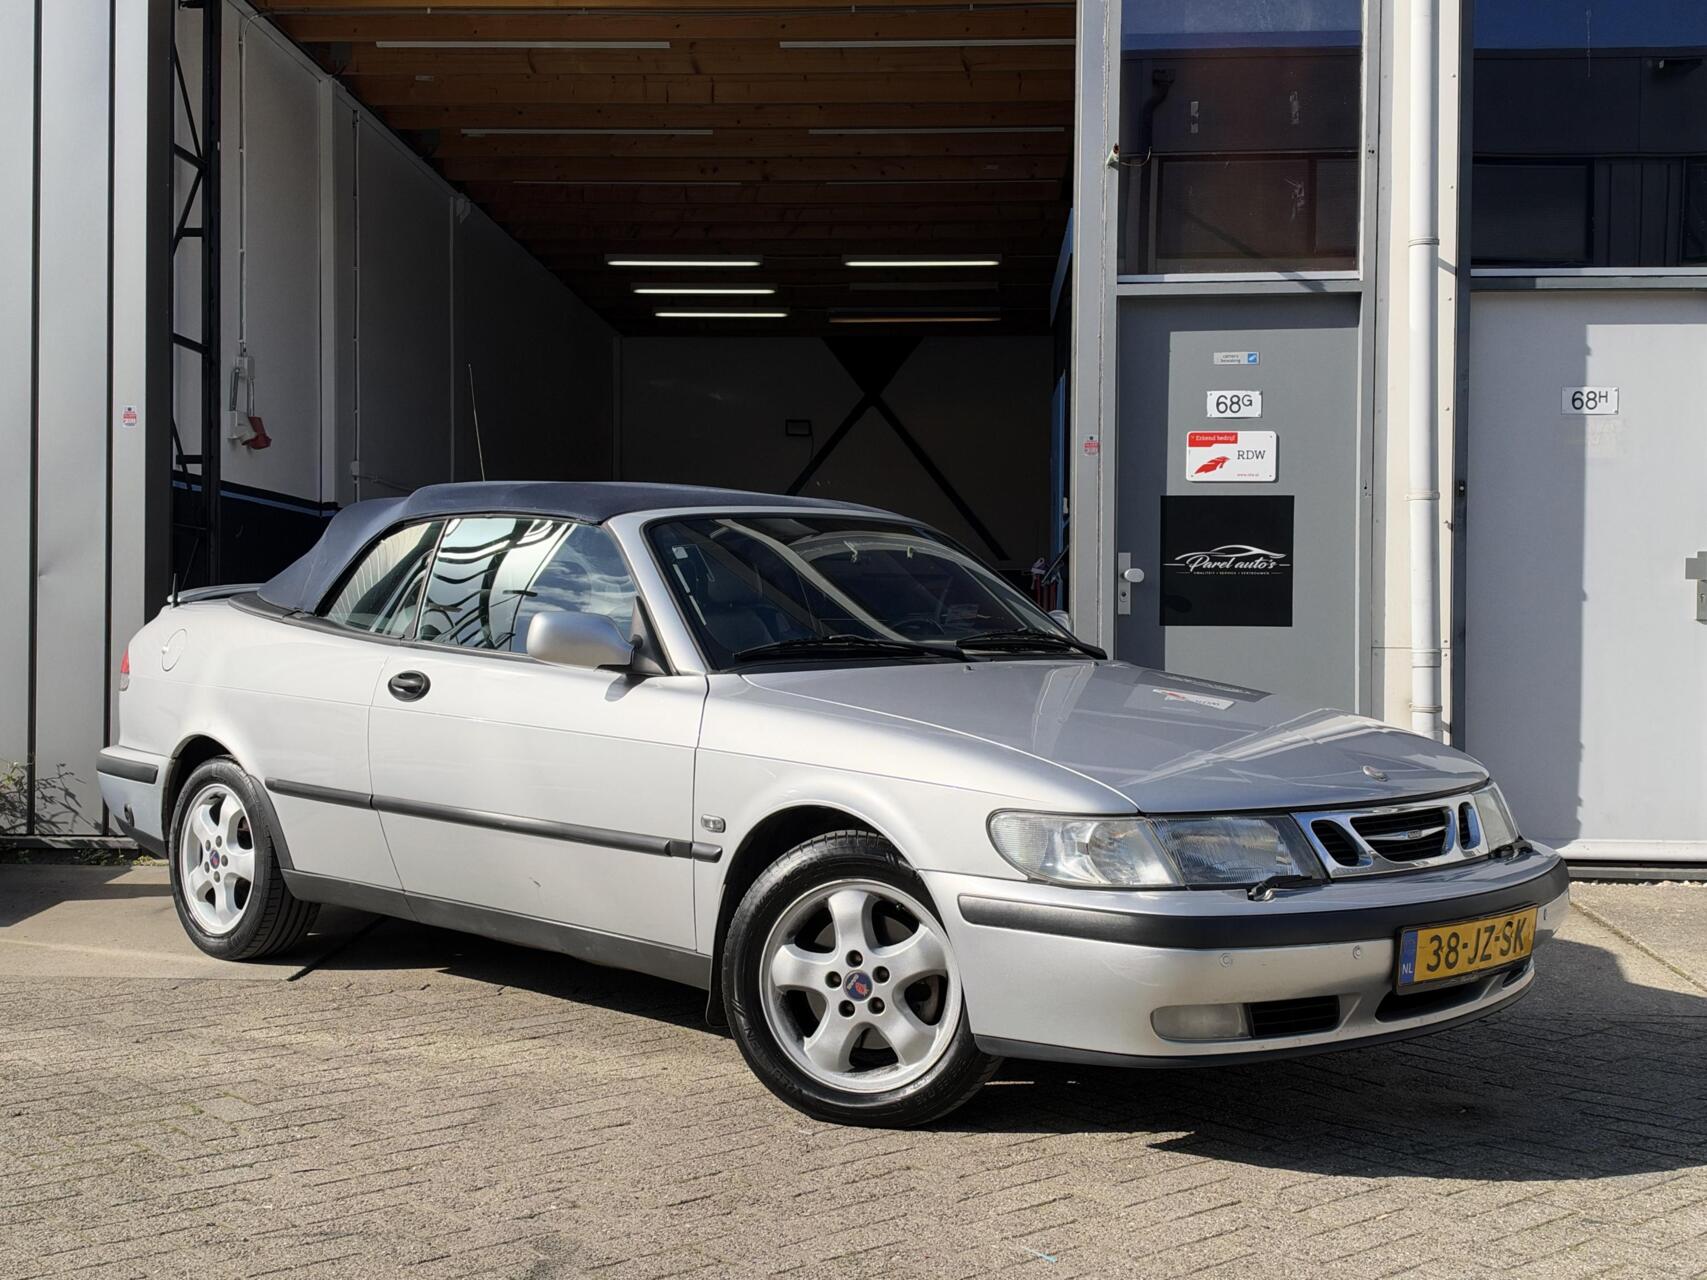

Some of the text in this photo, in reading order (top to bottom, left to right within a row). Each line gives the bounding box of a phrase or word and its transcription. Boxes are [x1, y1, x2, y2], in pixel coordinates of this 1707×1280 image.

[1215, 394, 1253, 414] 68G
[1571, 390, 1608, 410] 68H
[1237, 450, 1266, 460] RDW
[1186, 554, 1277, 573] Parel auto's
[1426, 917, 1528, 973] 38-JZ-SK
[1401, 962, 1414, 974] NL
